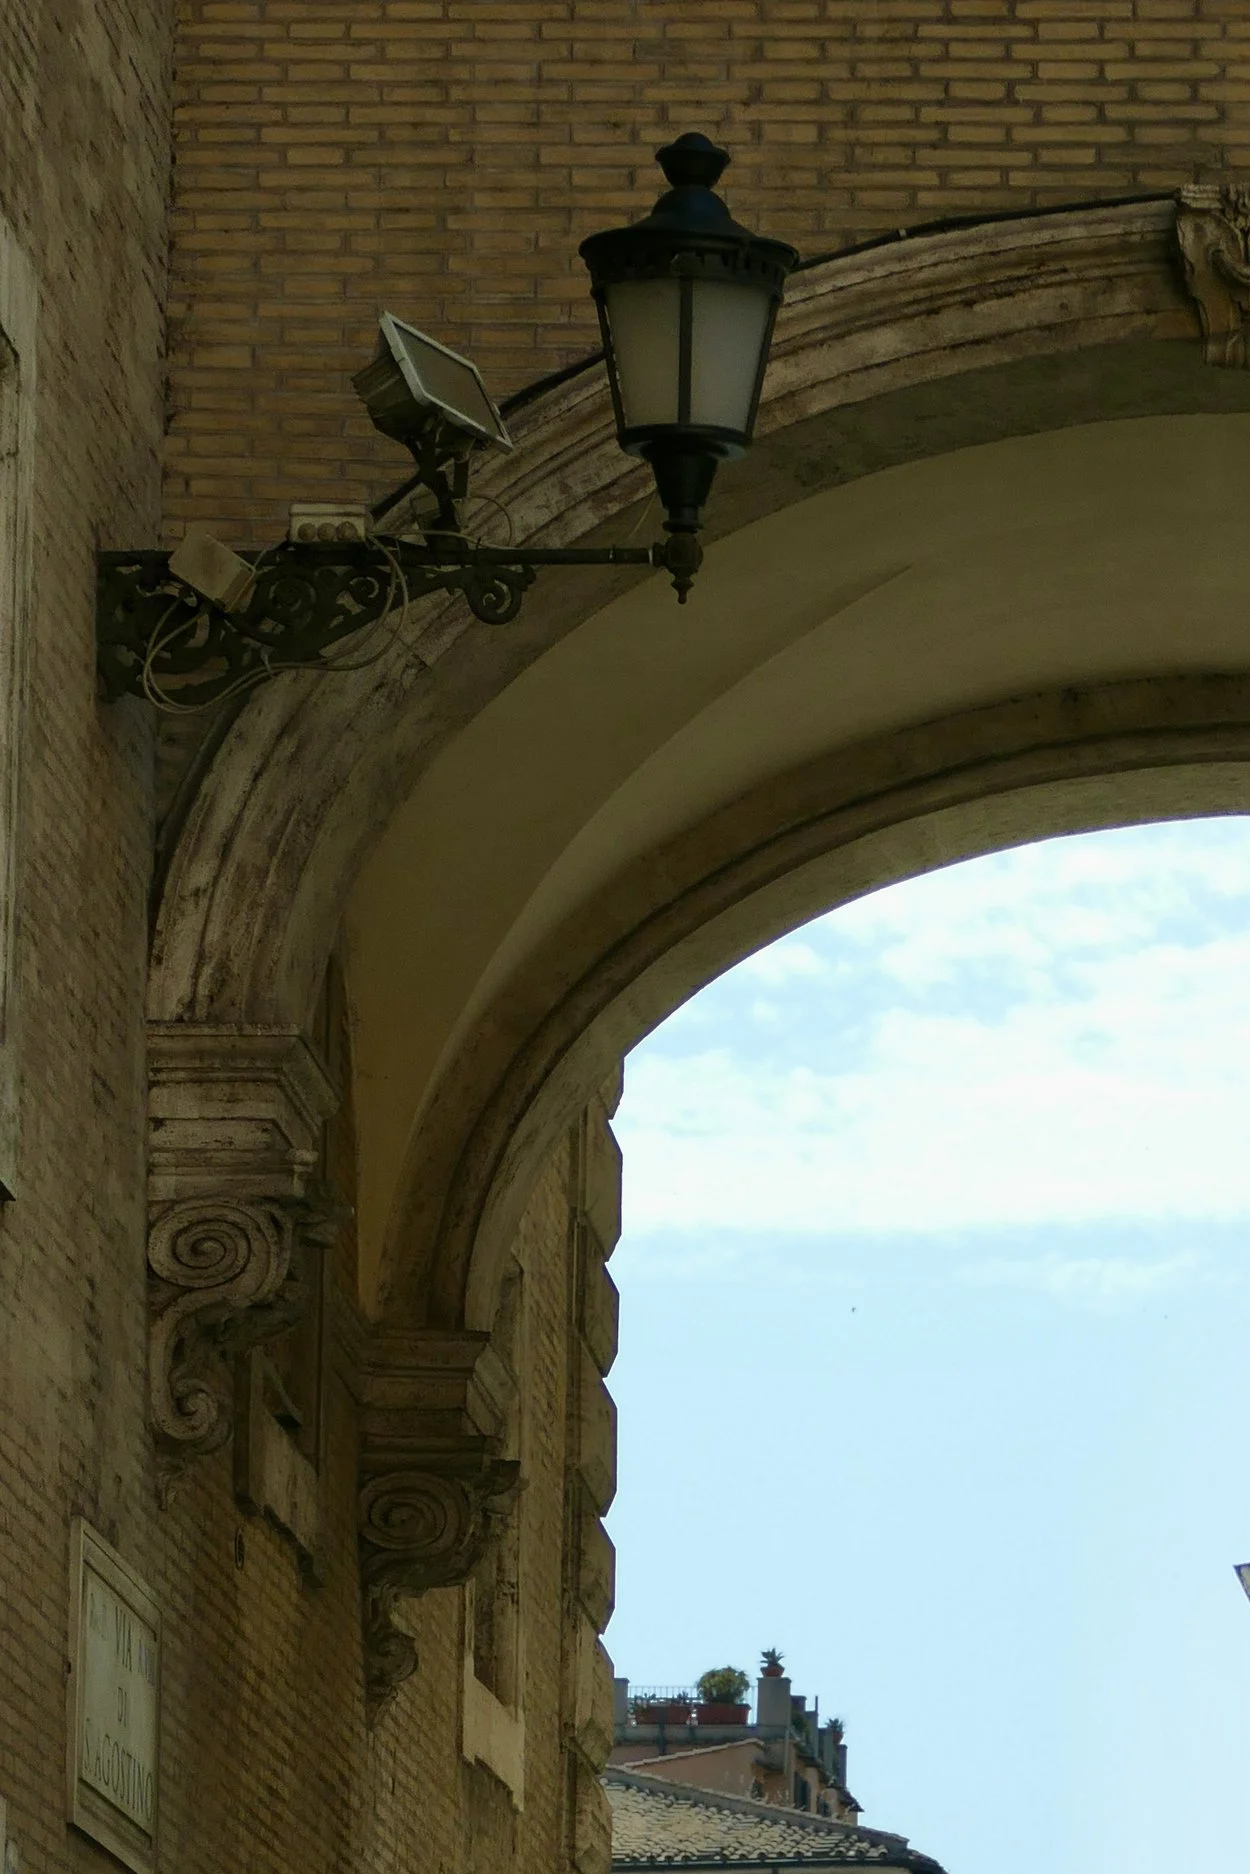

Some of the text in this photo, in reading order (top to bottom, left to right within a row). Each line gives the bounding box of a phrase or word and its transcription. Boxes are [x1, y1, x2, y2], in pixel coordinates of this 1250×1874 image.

[114, 1604, 133, 1673] VIA
[116, 1686, 127, 1728] DI
[95, 1732, 153, 1823] AGOSTINO
